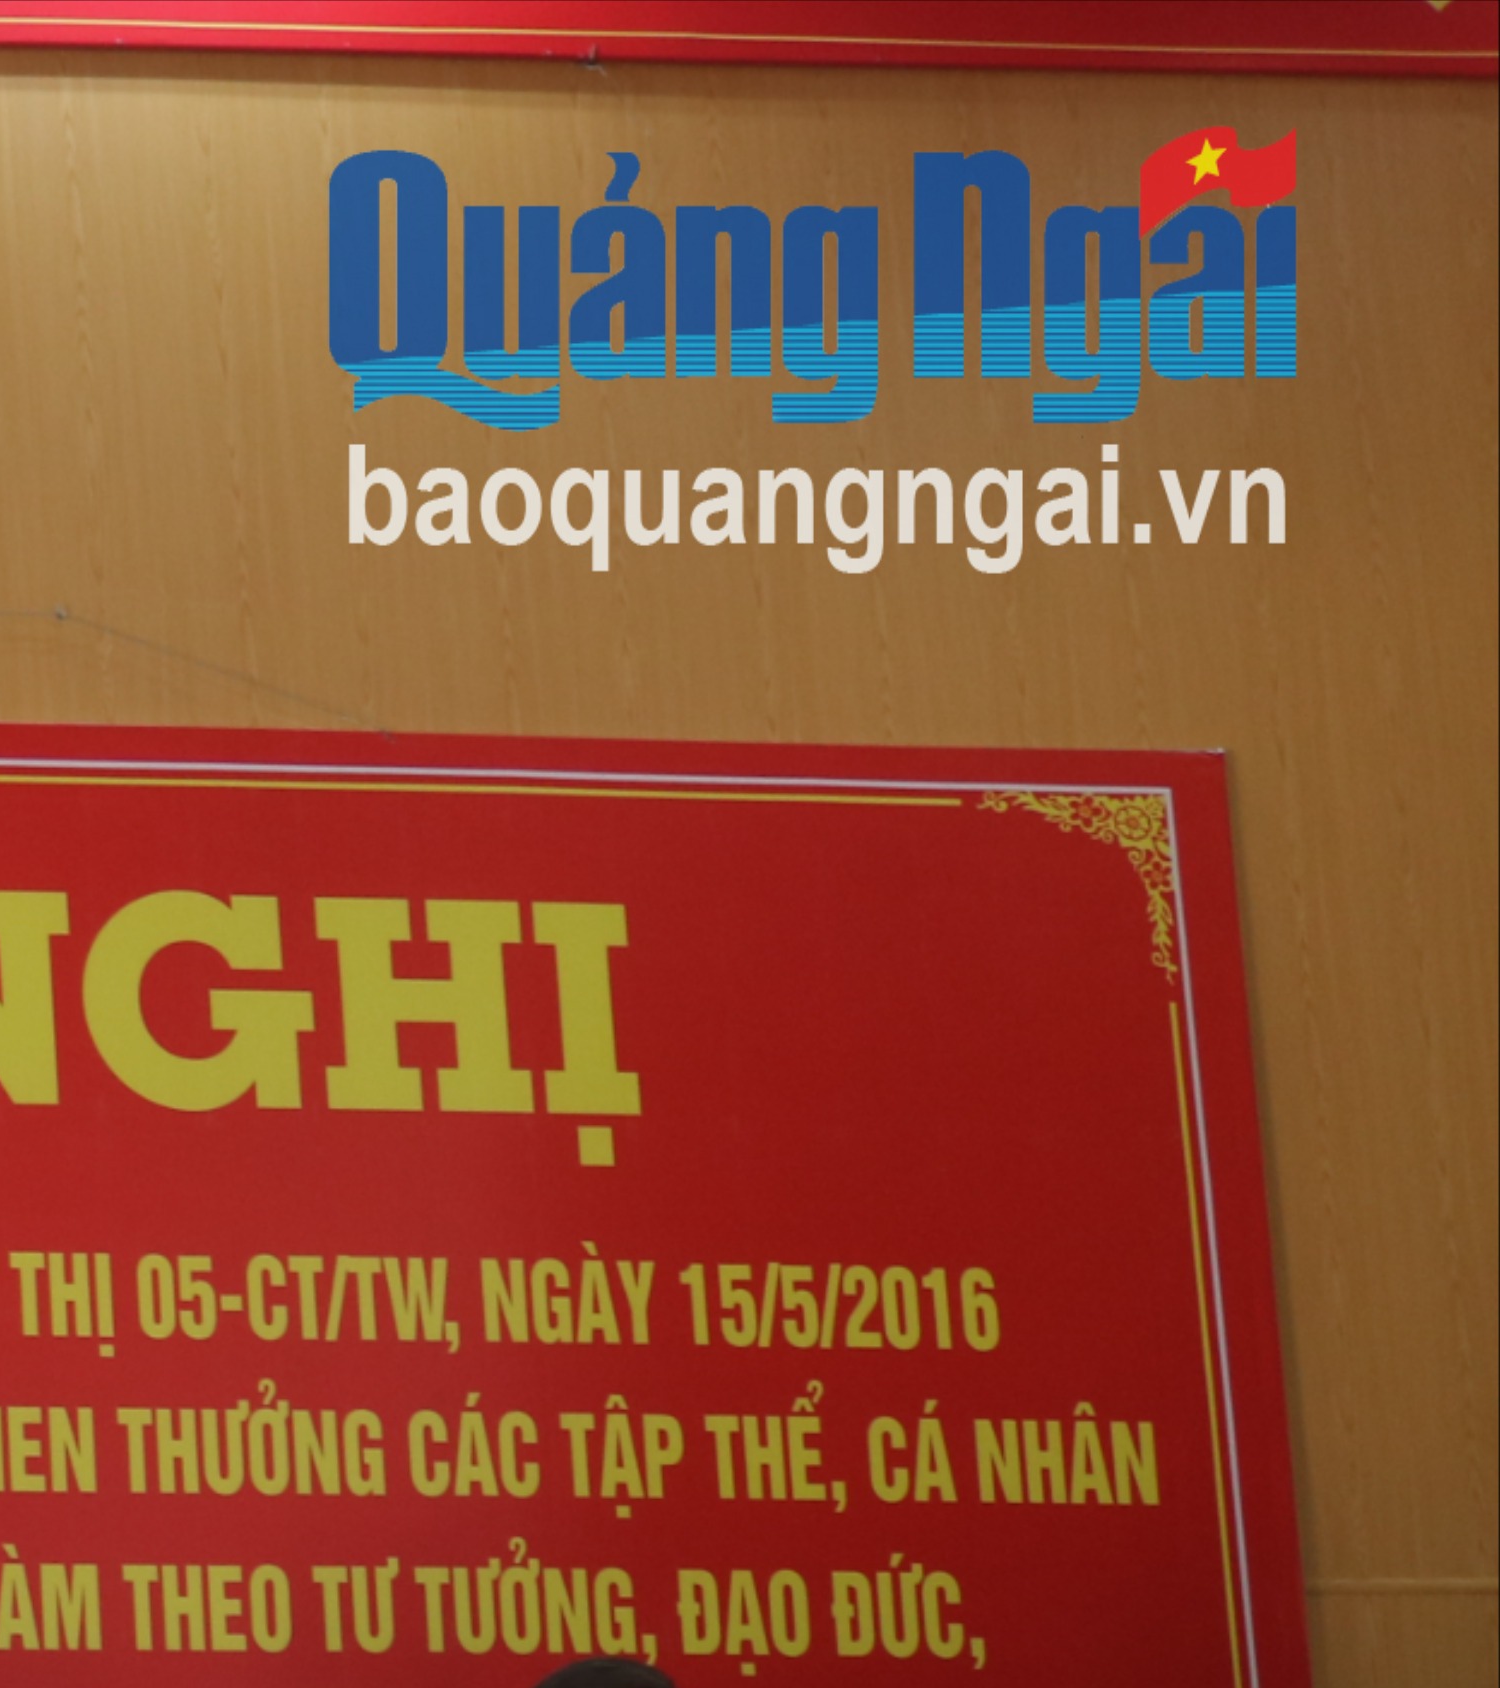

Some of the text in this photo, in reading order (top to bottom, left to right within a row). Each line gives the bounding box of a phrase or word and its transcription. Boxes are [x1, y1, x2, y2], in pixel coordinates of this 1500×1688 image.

[9, 1252, 114, 1357] THỊ
[137, 1254, 459, 1352] 05-CT/TW,
[481, 1242, 653, 1343] NGÀY
[681, 1263, 998, 1350] 15/5/2016
[117, 1379, 385, 1496] THƯỞNG
[409, 1393, 539, 1497] CÁC
[561, 1395, 683, 1517] TẬP
[706, 1381, 845, 1511] THỂ,
[869, 1400, 956, 1501] CÁ
[976, 1403, 1157, 1504] NHÂN
[123, 1565, 291, 1652] THEO
[313, 1558, 399, 1652] TƯ
[415, 1537, 656, 1664] TƯỞNG,
[678, 1570, 809, 1674] ĐẠO
[833, 1554, 984, 1667] ĐỨC,
